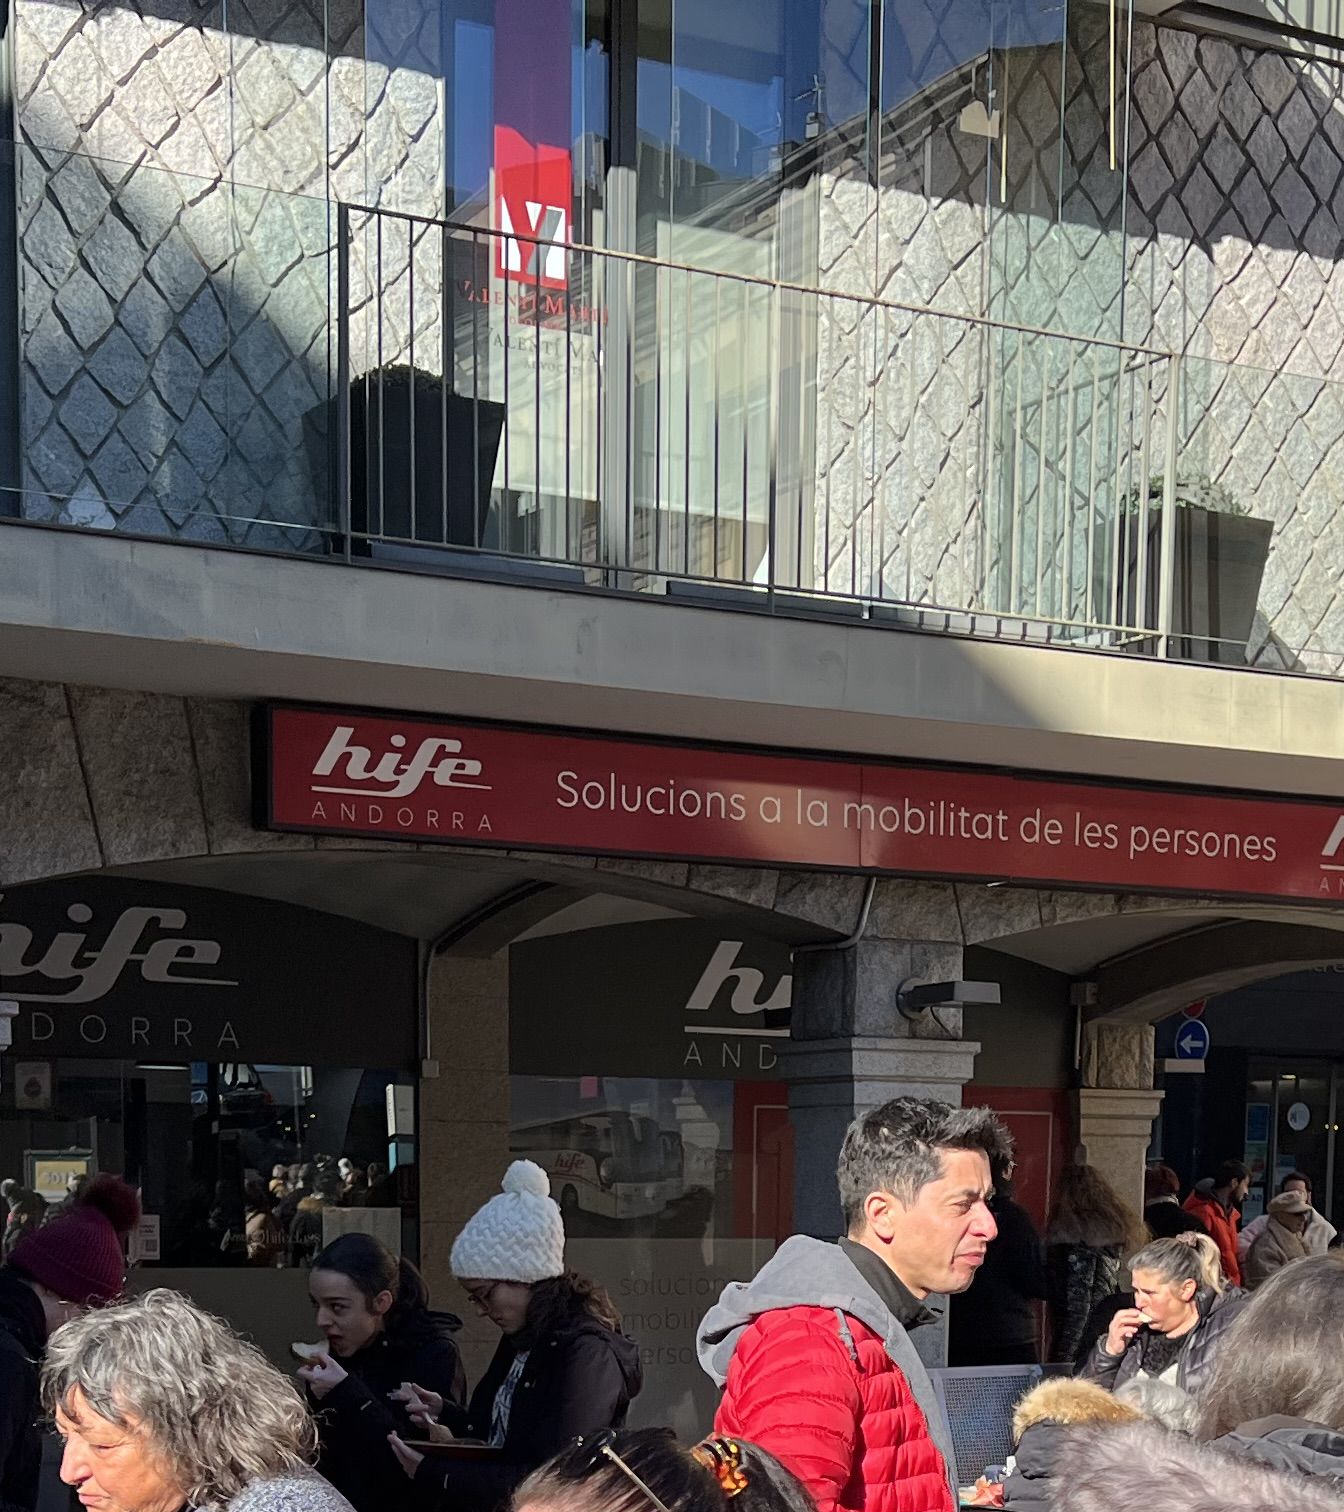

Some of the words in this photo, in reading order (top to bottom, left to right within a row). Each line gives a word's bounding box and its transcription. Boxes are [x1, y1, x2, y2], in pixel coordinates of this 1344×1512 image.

[312, 727, 492, 797] hife
[312, 801, 492, 832] ANDORRA
[556, 771, 746, 821] Solucions
[759, 796, 781, 823] a
[798, 789, 827, 828] la
[844, 798, 1009, 842] mobilitat
[1019, 808, 1063, 846] de
[1074, 812, 1119, 851] les
[1129, 824, 1278, 862] persones
[684, 1040, 777, 1070] AND
